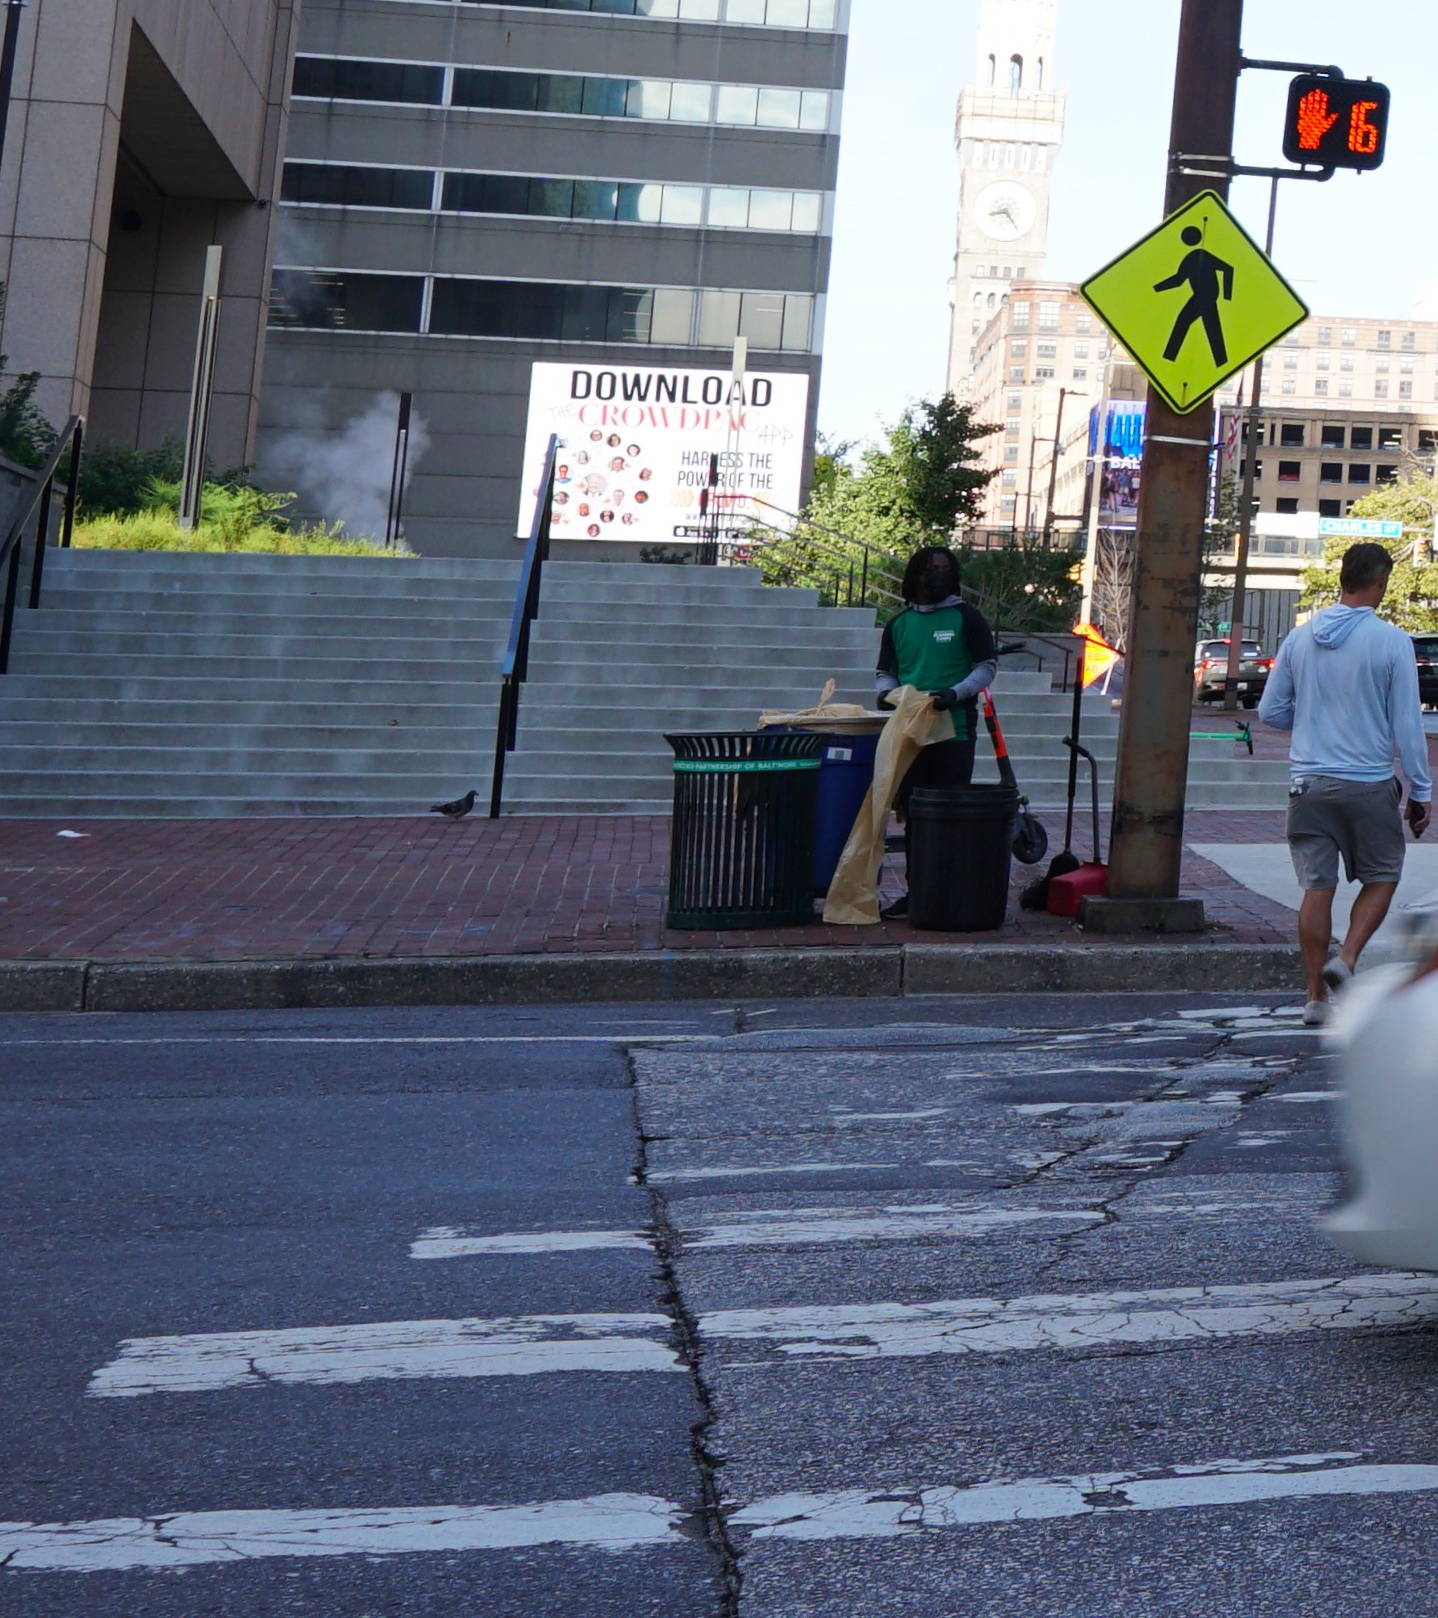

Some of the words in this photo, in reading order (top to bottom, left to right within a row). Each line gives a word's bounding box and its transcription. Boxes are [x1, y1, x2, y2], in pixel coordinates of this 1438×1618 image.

[1347, 100, 1379, 155] 16
[570, 370, 772, 407] DOWNLOAD
[578, 404, 762, 432] CROWDPAC
[682, 451, 744, 469] HARESS
[749, 452, 773, 469] THE
[678, 470, 725, 487] POWR
[728, 472, 744, 487] OF
[750, 473, 773, 489] THE
